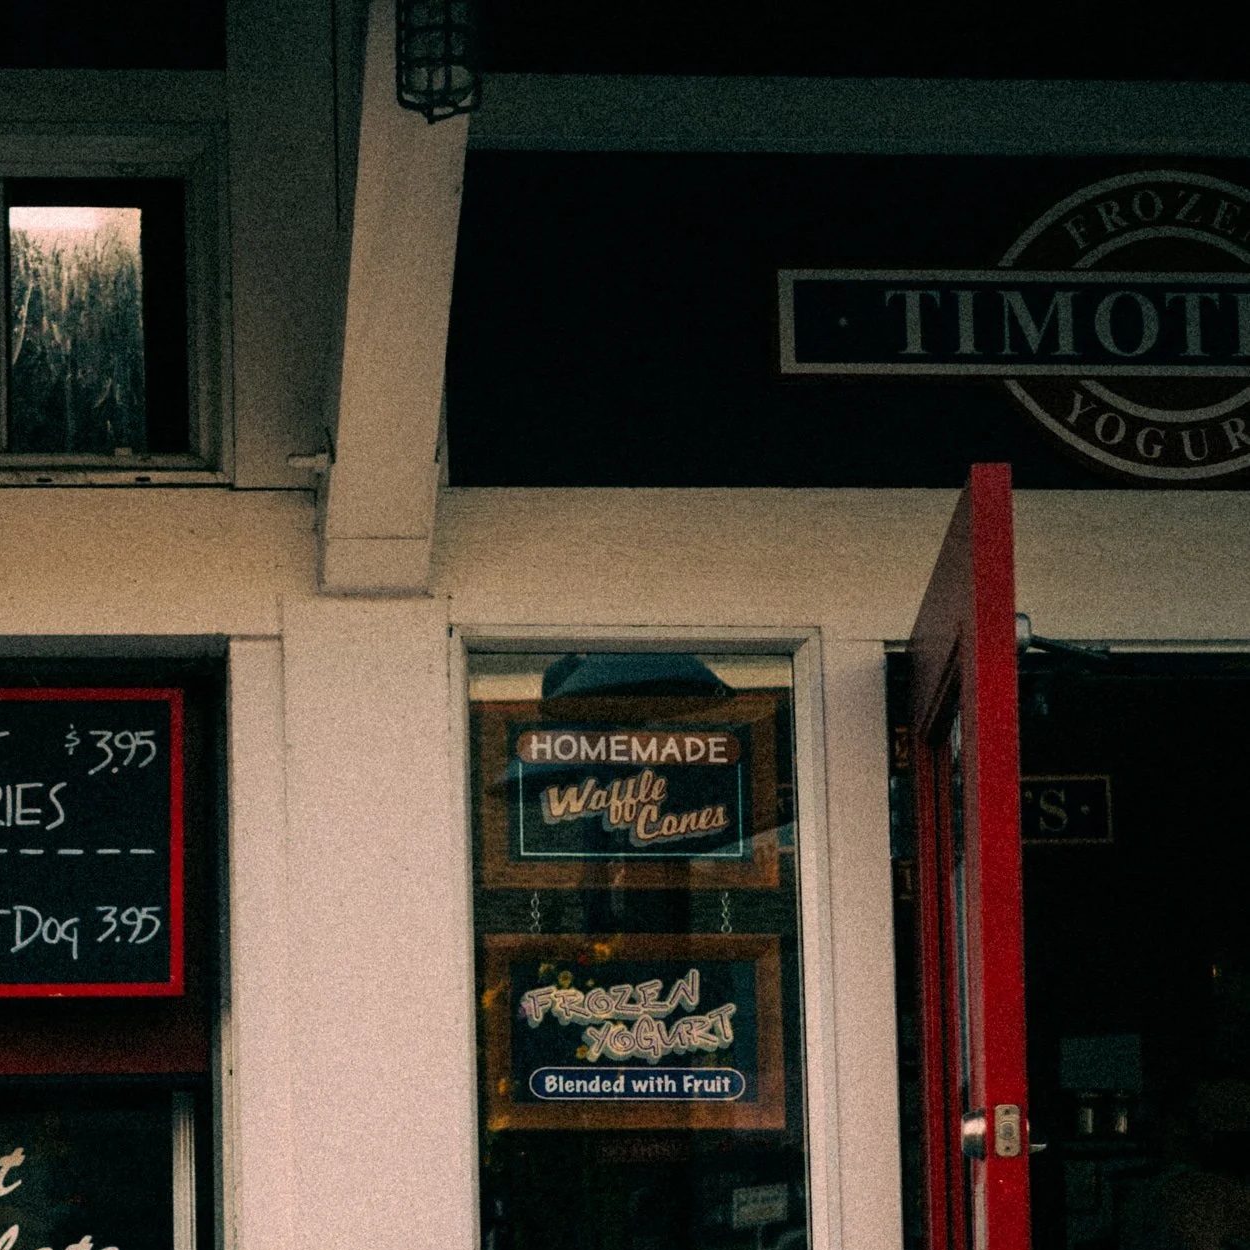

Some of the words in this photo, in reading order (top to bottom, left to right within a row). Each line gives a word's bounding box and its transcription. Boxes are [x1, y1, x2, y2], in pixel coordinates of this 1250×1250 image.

[1062, 189, 1250, 250] FROZE
[884, 289, 1250, 358] TIMOT
[63, 724, 157, 776] $3.95
[530, 734, 729, 763] HOMEMADE
[541, 768, 668, 832] Waffle
[630, 803, 730, 847] Cones
[95, 905, 161, 946] 3.95
[520, 968, 699, 1028] FROZEN
[584, 1003, 736, 1063] YOGURT
[544, 1075, 625, 1094] Blended
[631, 1076, 677, 1094] with
[682, 1075, 731, 1094] Fruit
